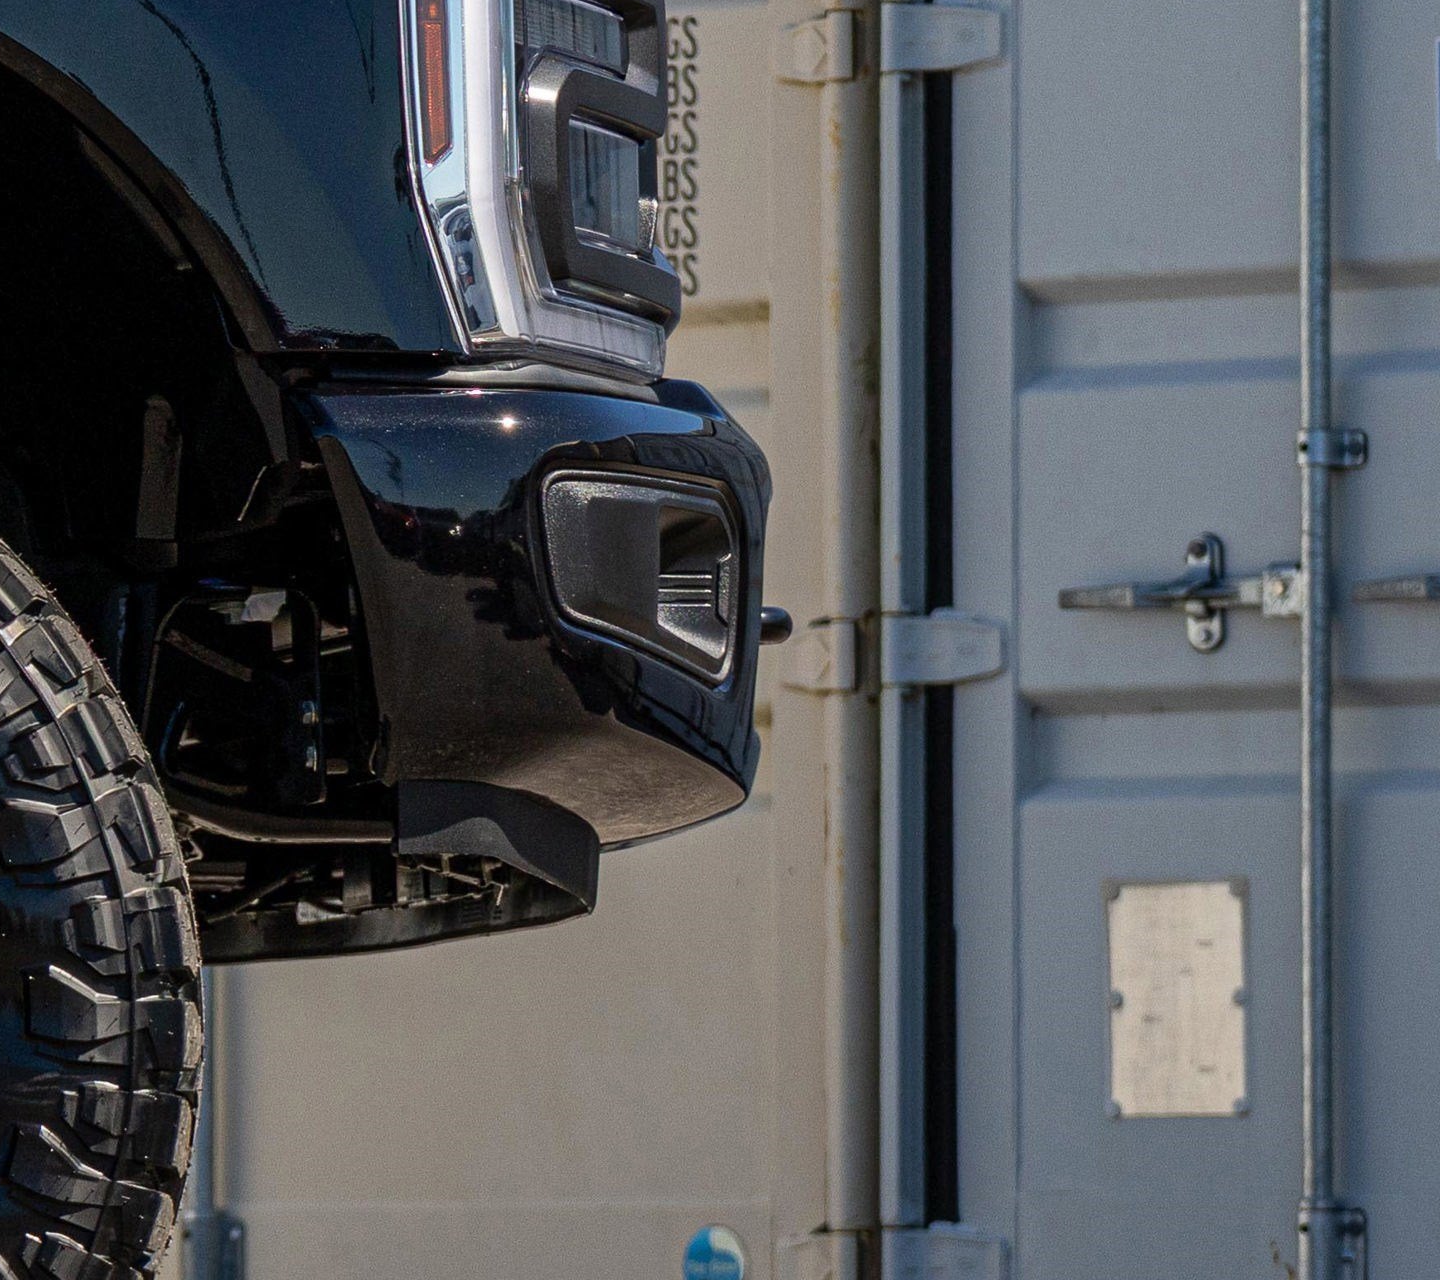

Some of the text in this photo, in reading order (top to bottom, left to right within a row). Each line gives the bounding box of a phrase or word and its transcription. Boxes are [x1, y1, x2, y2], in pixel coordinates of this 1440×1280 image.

[666, 16, 698, 60] GS
[667, 64, 698, 107] BS
[664, 111, 698, 155] GS
[660, 159, 698, 202] BS
[660, 205, 698, 248] GS
